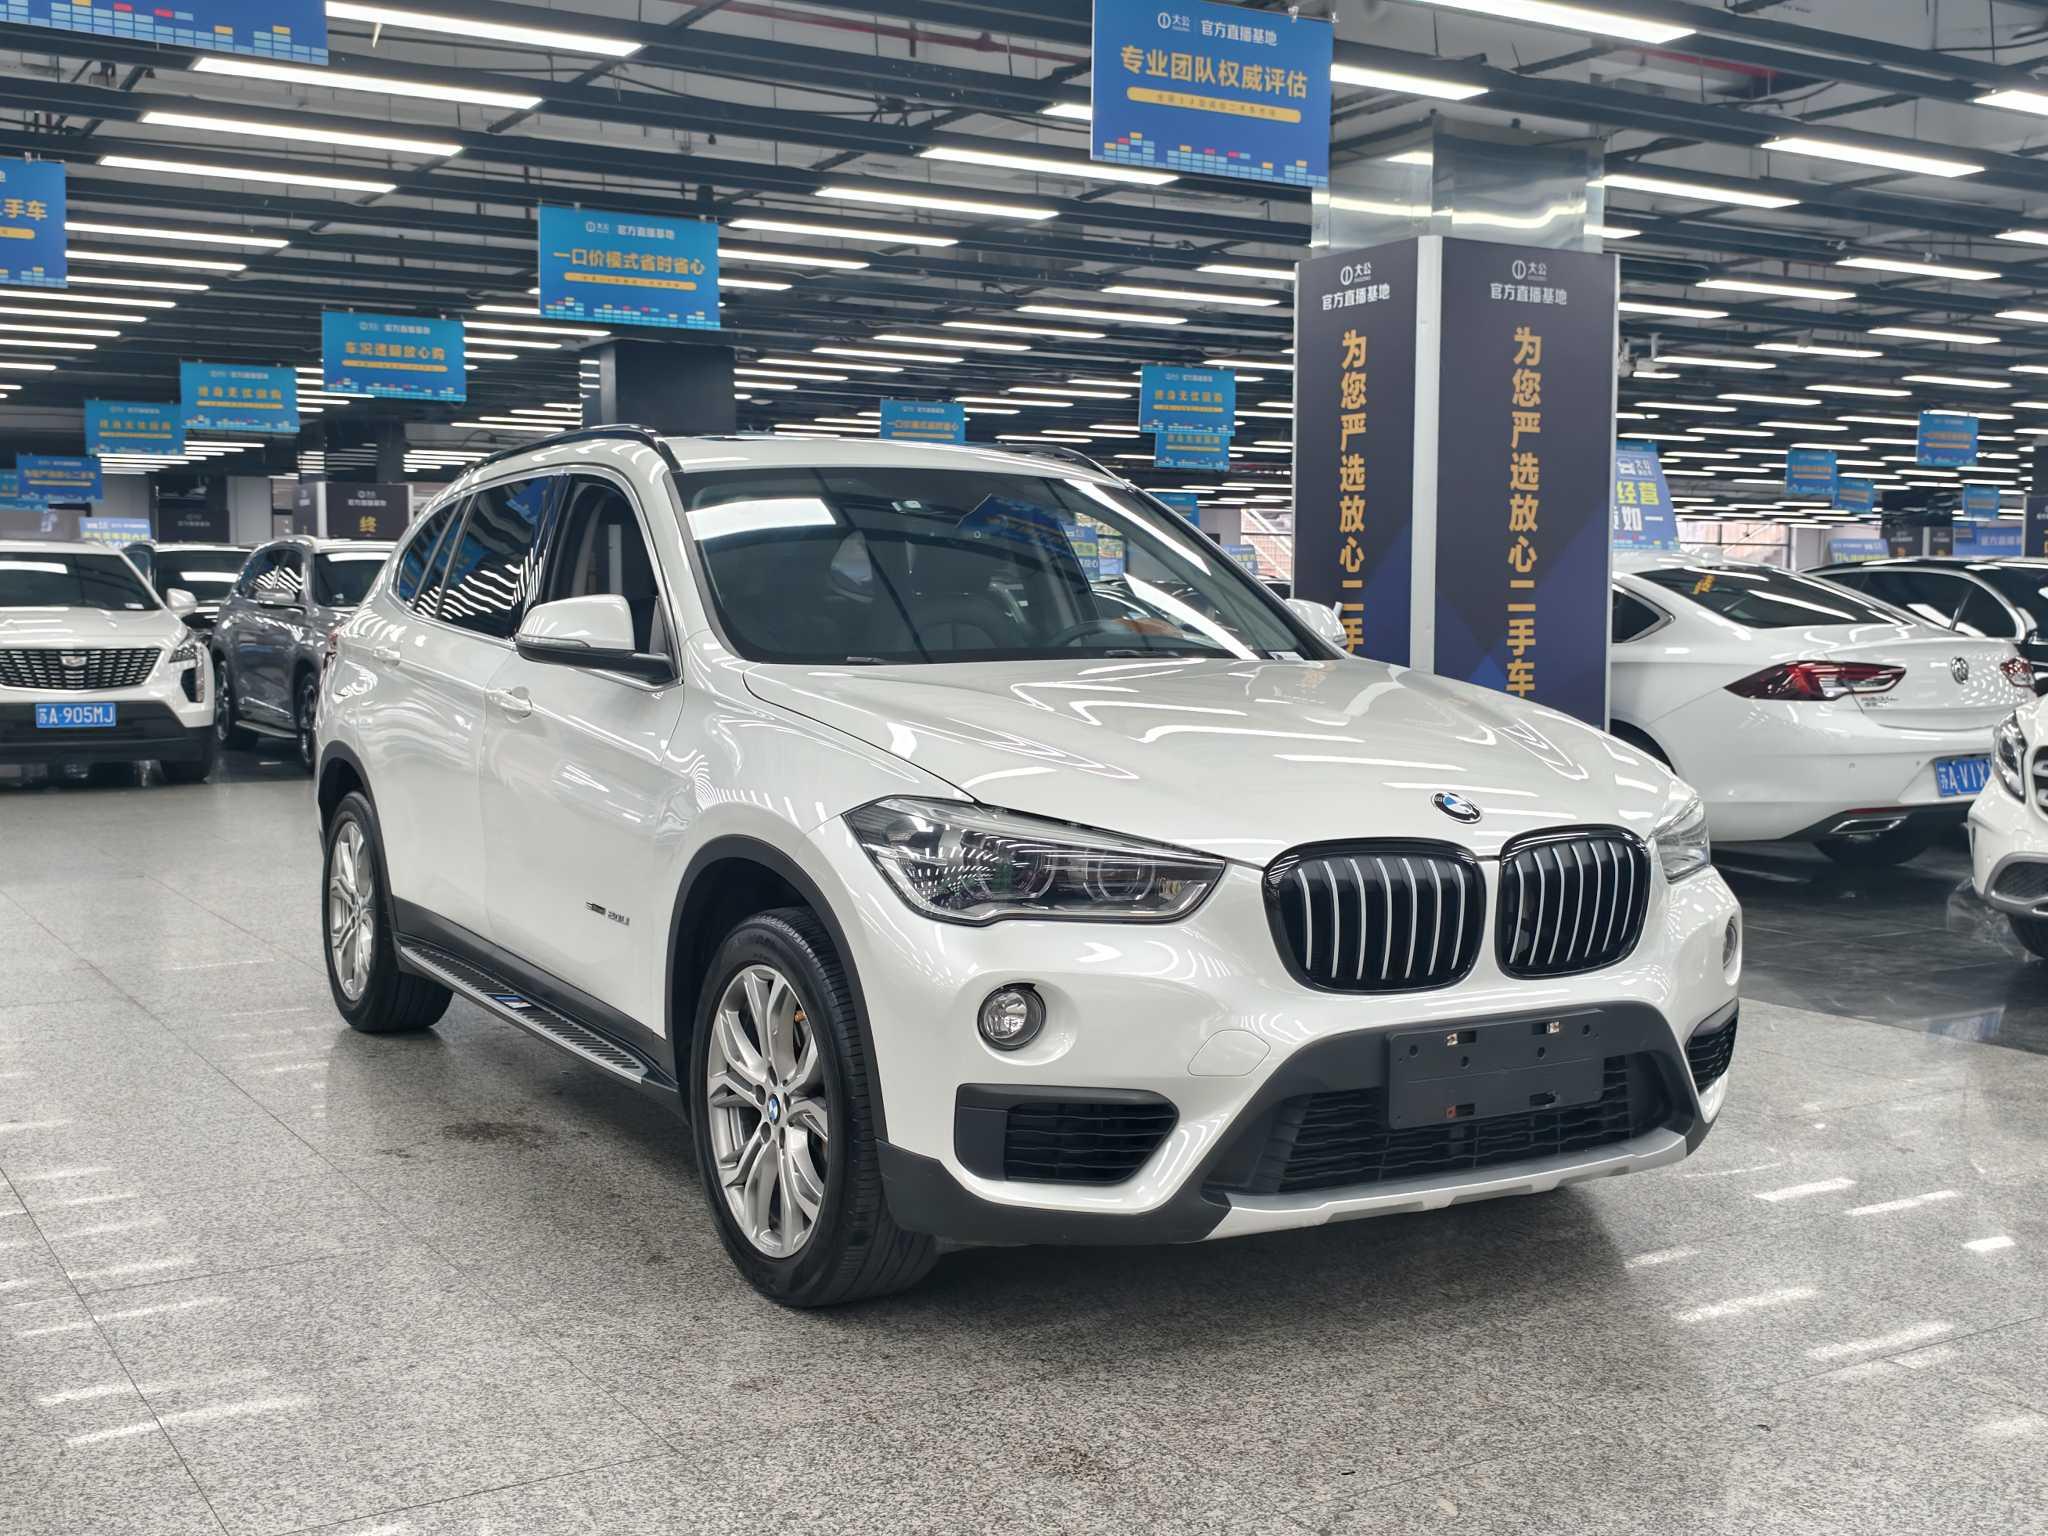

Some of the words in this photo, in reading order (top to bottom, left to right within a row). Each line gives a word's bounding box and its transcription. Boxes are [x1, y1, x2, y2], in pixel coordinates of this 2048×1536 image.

[1172, 15, 1191, 27] 大公
[1201, 19, 1278, 46] 官方直播基地
[1120, 45, 1308, 98] 专业团队权威评估
[0, 198, 48, 220] 手车
[553, 248, 705, 275] 一口价模式省时省心
[1322, 283, 1390, 310] 官方直播基地
[1490, 283, 1567, 305] 官方直播基地
[1507, 326, 1542, 698] 为您严选放心二手车
